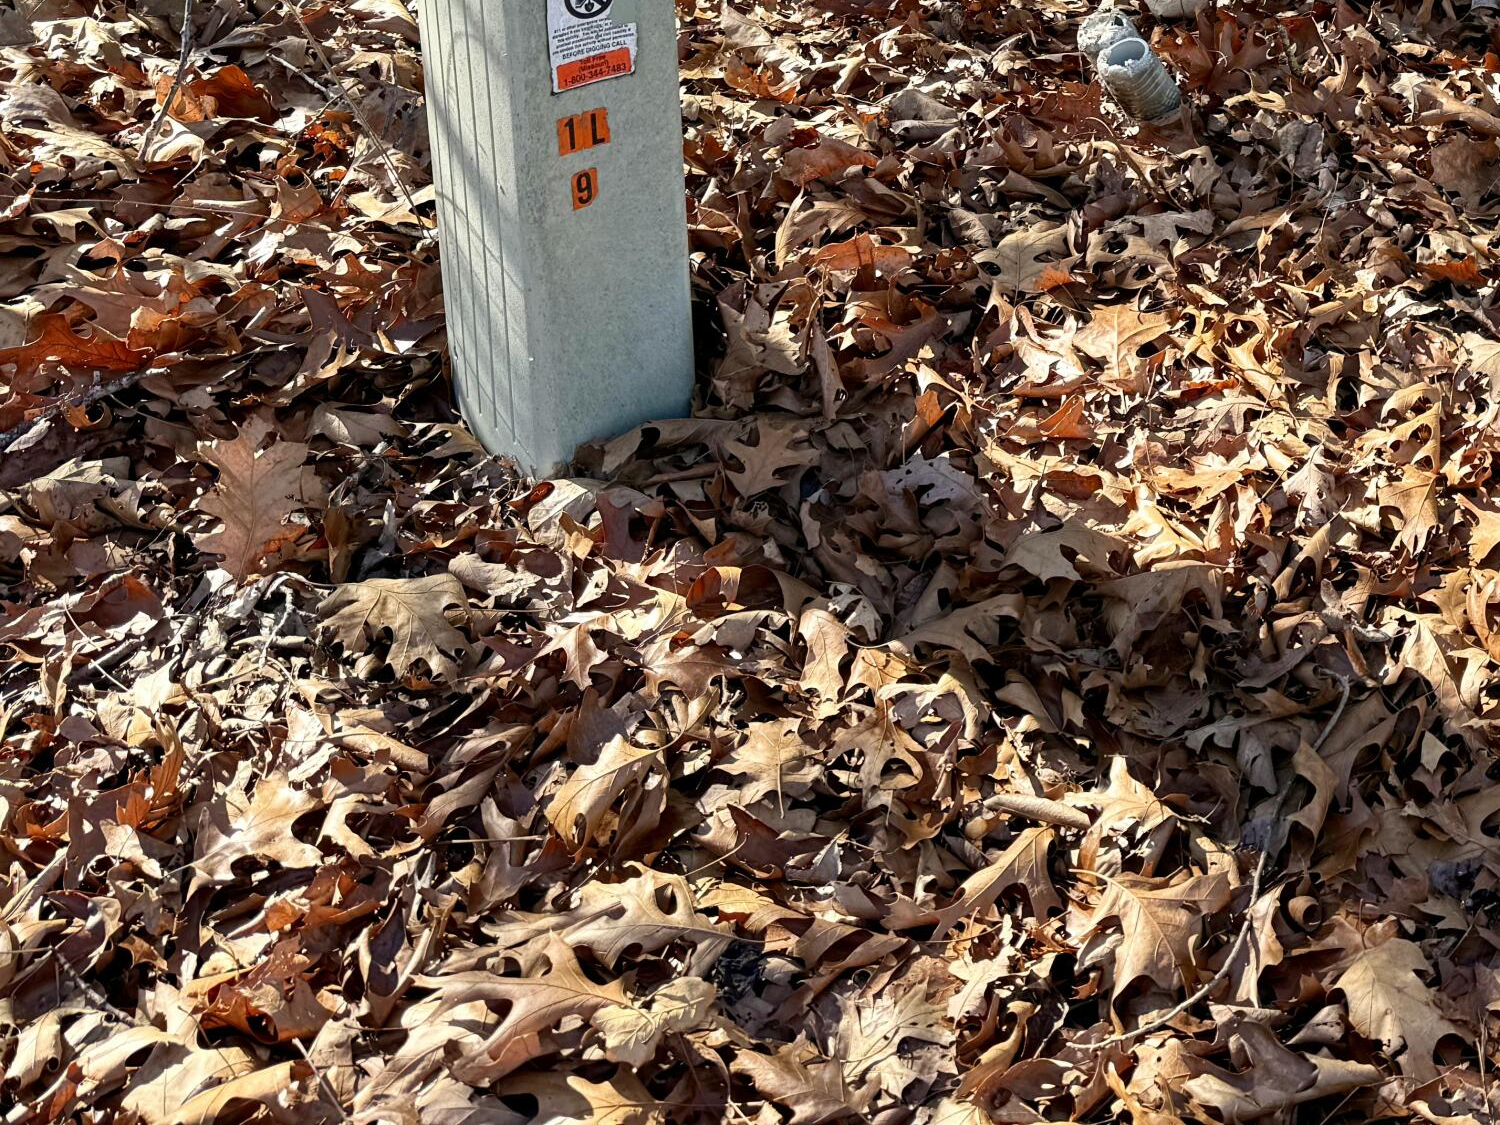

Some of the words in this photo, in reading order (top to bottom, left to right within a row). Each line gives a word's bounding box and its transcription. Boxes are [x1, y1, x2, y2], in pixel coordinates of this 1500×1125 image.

[562, 48, 585, 60] BEFORE
[585, 43, 611, 54] DIGGING
[611, 40, 627, 48] CALL
[576, 171, 592, 205] 9
